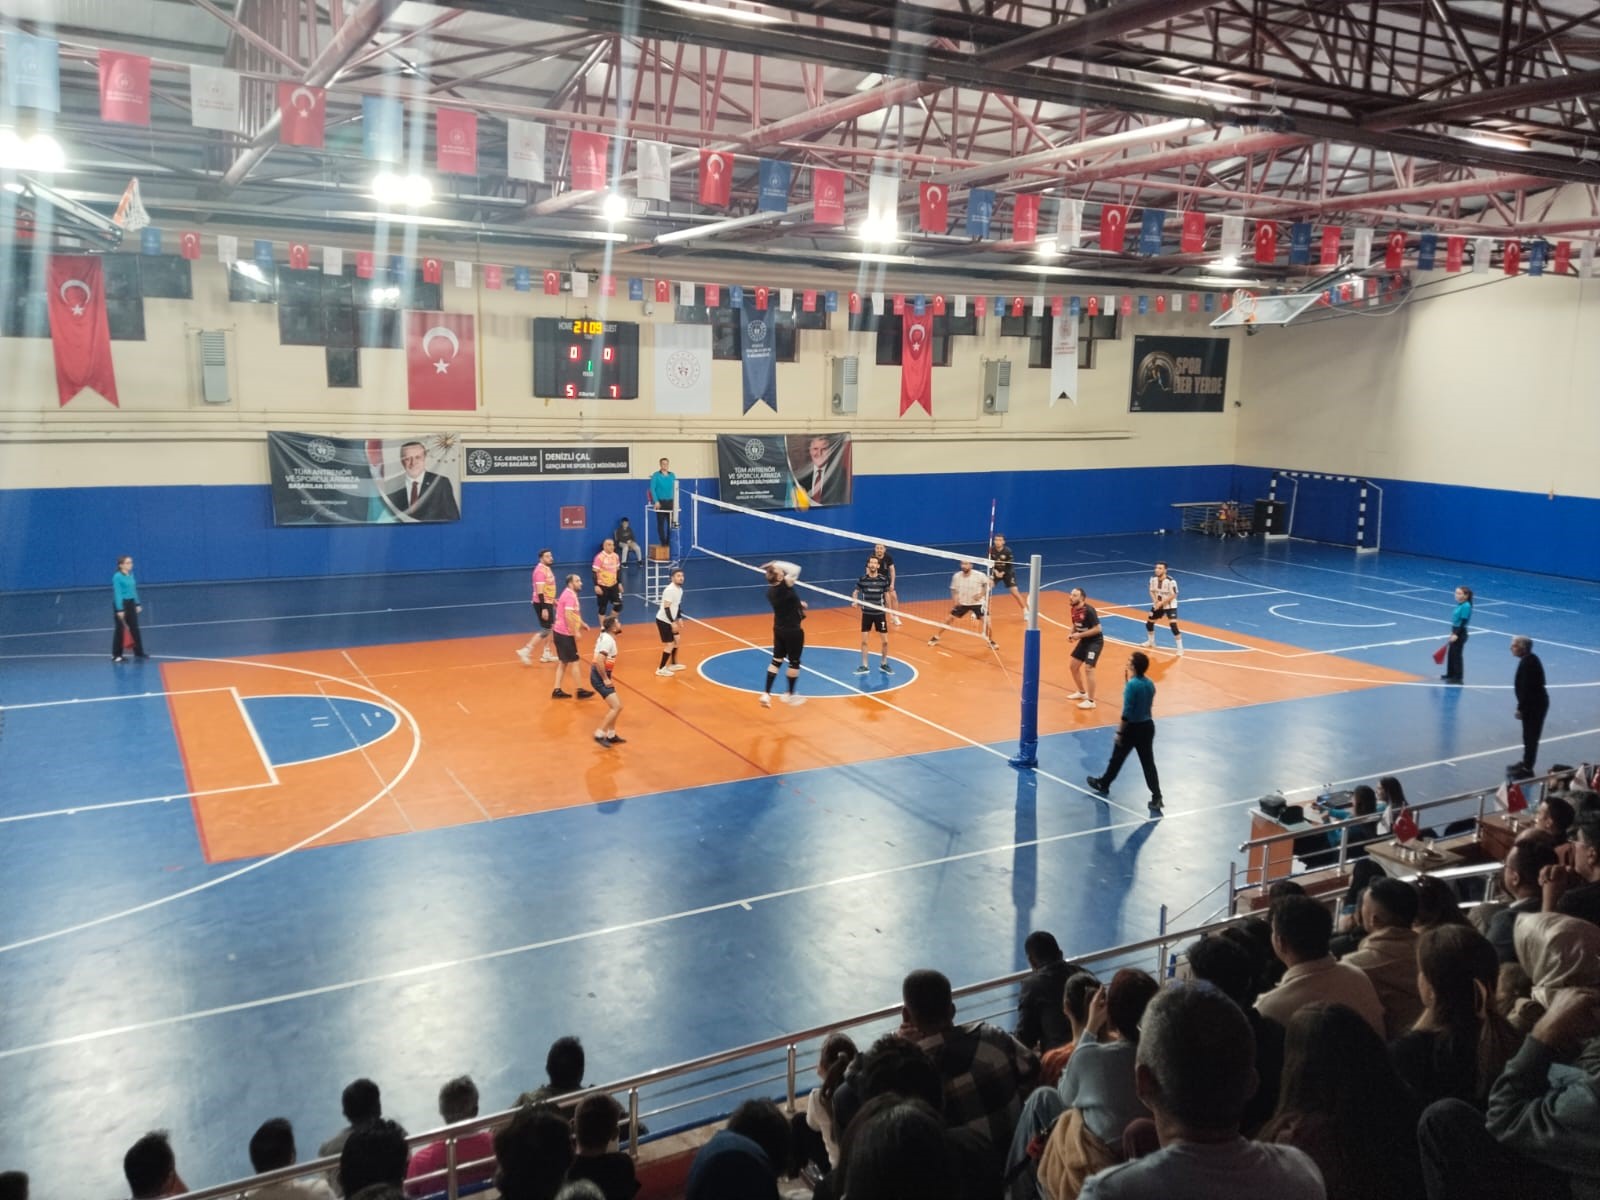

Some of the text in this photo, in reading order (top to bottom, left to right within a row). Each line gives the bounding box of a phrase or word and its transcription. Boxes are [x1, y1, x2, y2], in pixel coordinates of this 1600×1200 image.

[570, 346, 579, 359] 0
[603, 347, 612, 361] 0
[566, 384, 575, 397] 5
[609, 385, 618, 398] 7
[545, 452, 591, 462] DENİZLİ ÇAL
